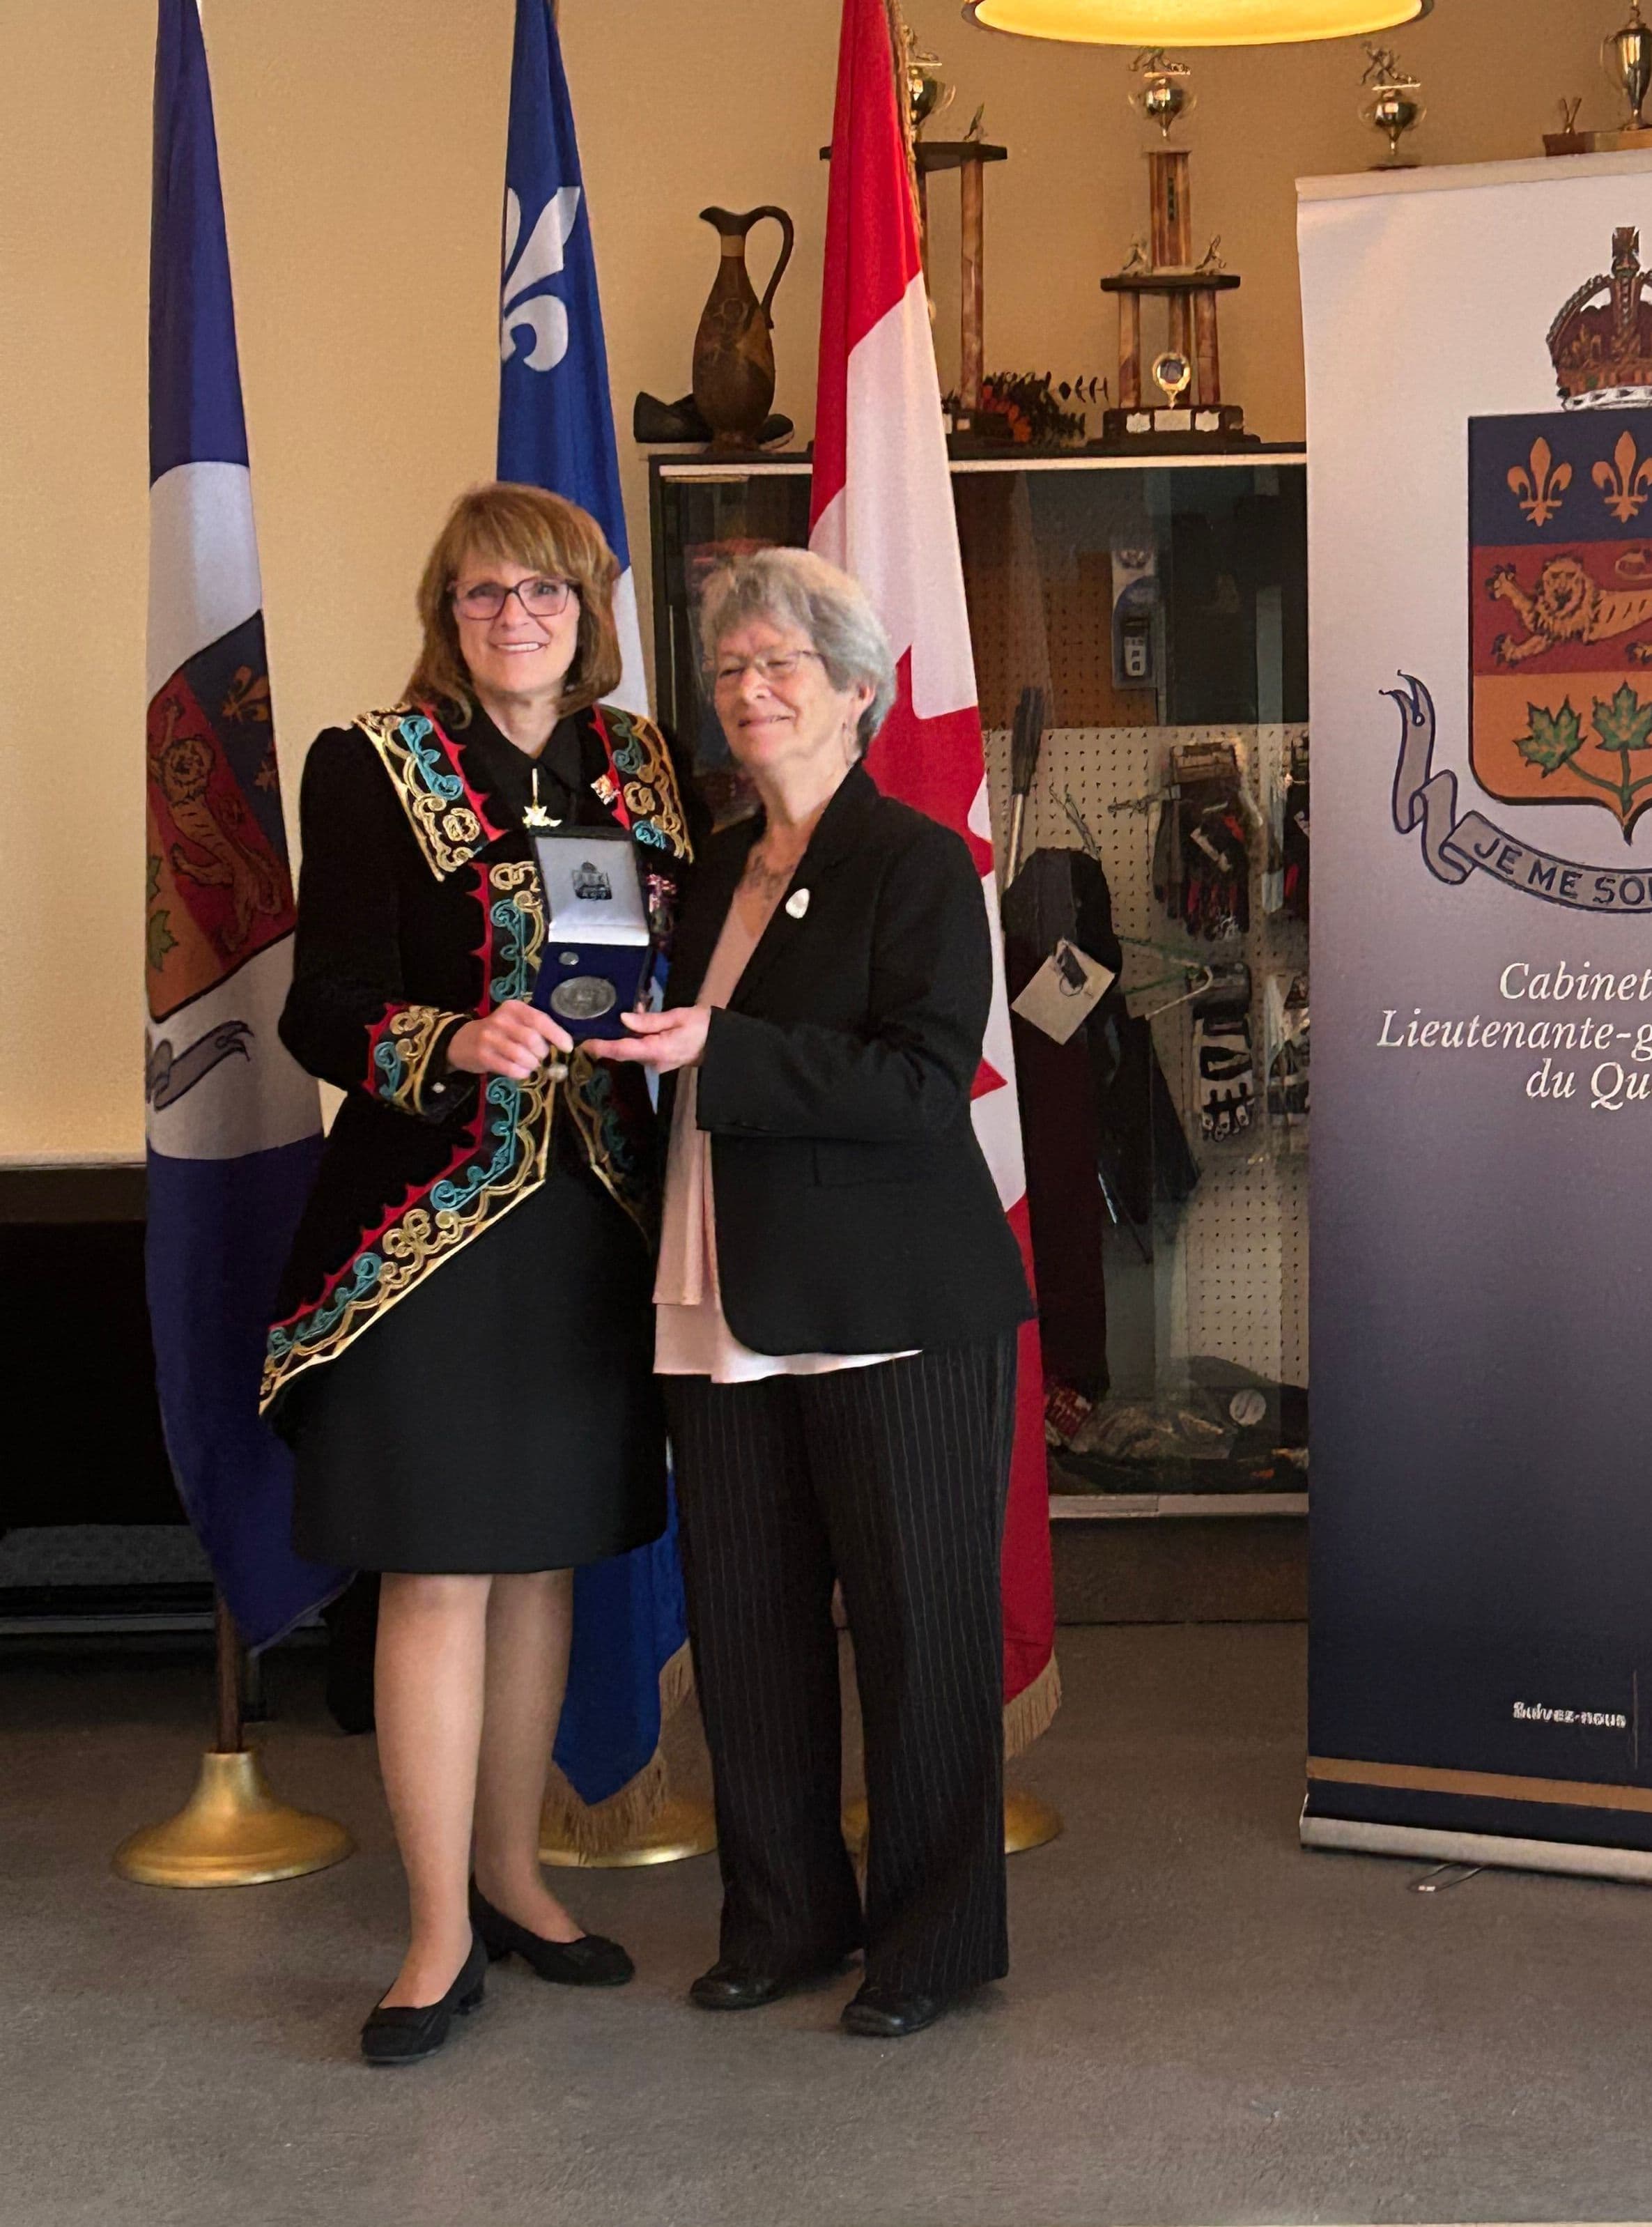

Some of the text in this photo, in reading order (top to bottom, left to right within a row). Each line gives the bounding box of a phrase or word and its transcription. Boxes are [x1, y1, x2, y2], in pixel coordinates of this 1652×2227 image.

[1474, 838, 1652, 906] JE ME SO
[1499, 960, 1652, 1001] Cabinet
[1525, 1058, 1576, 1098] du
